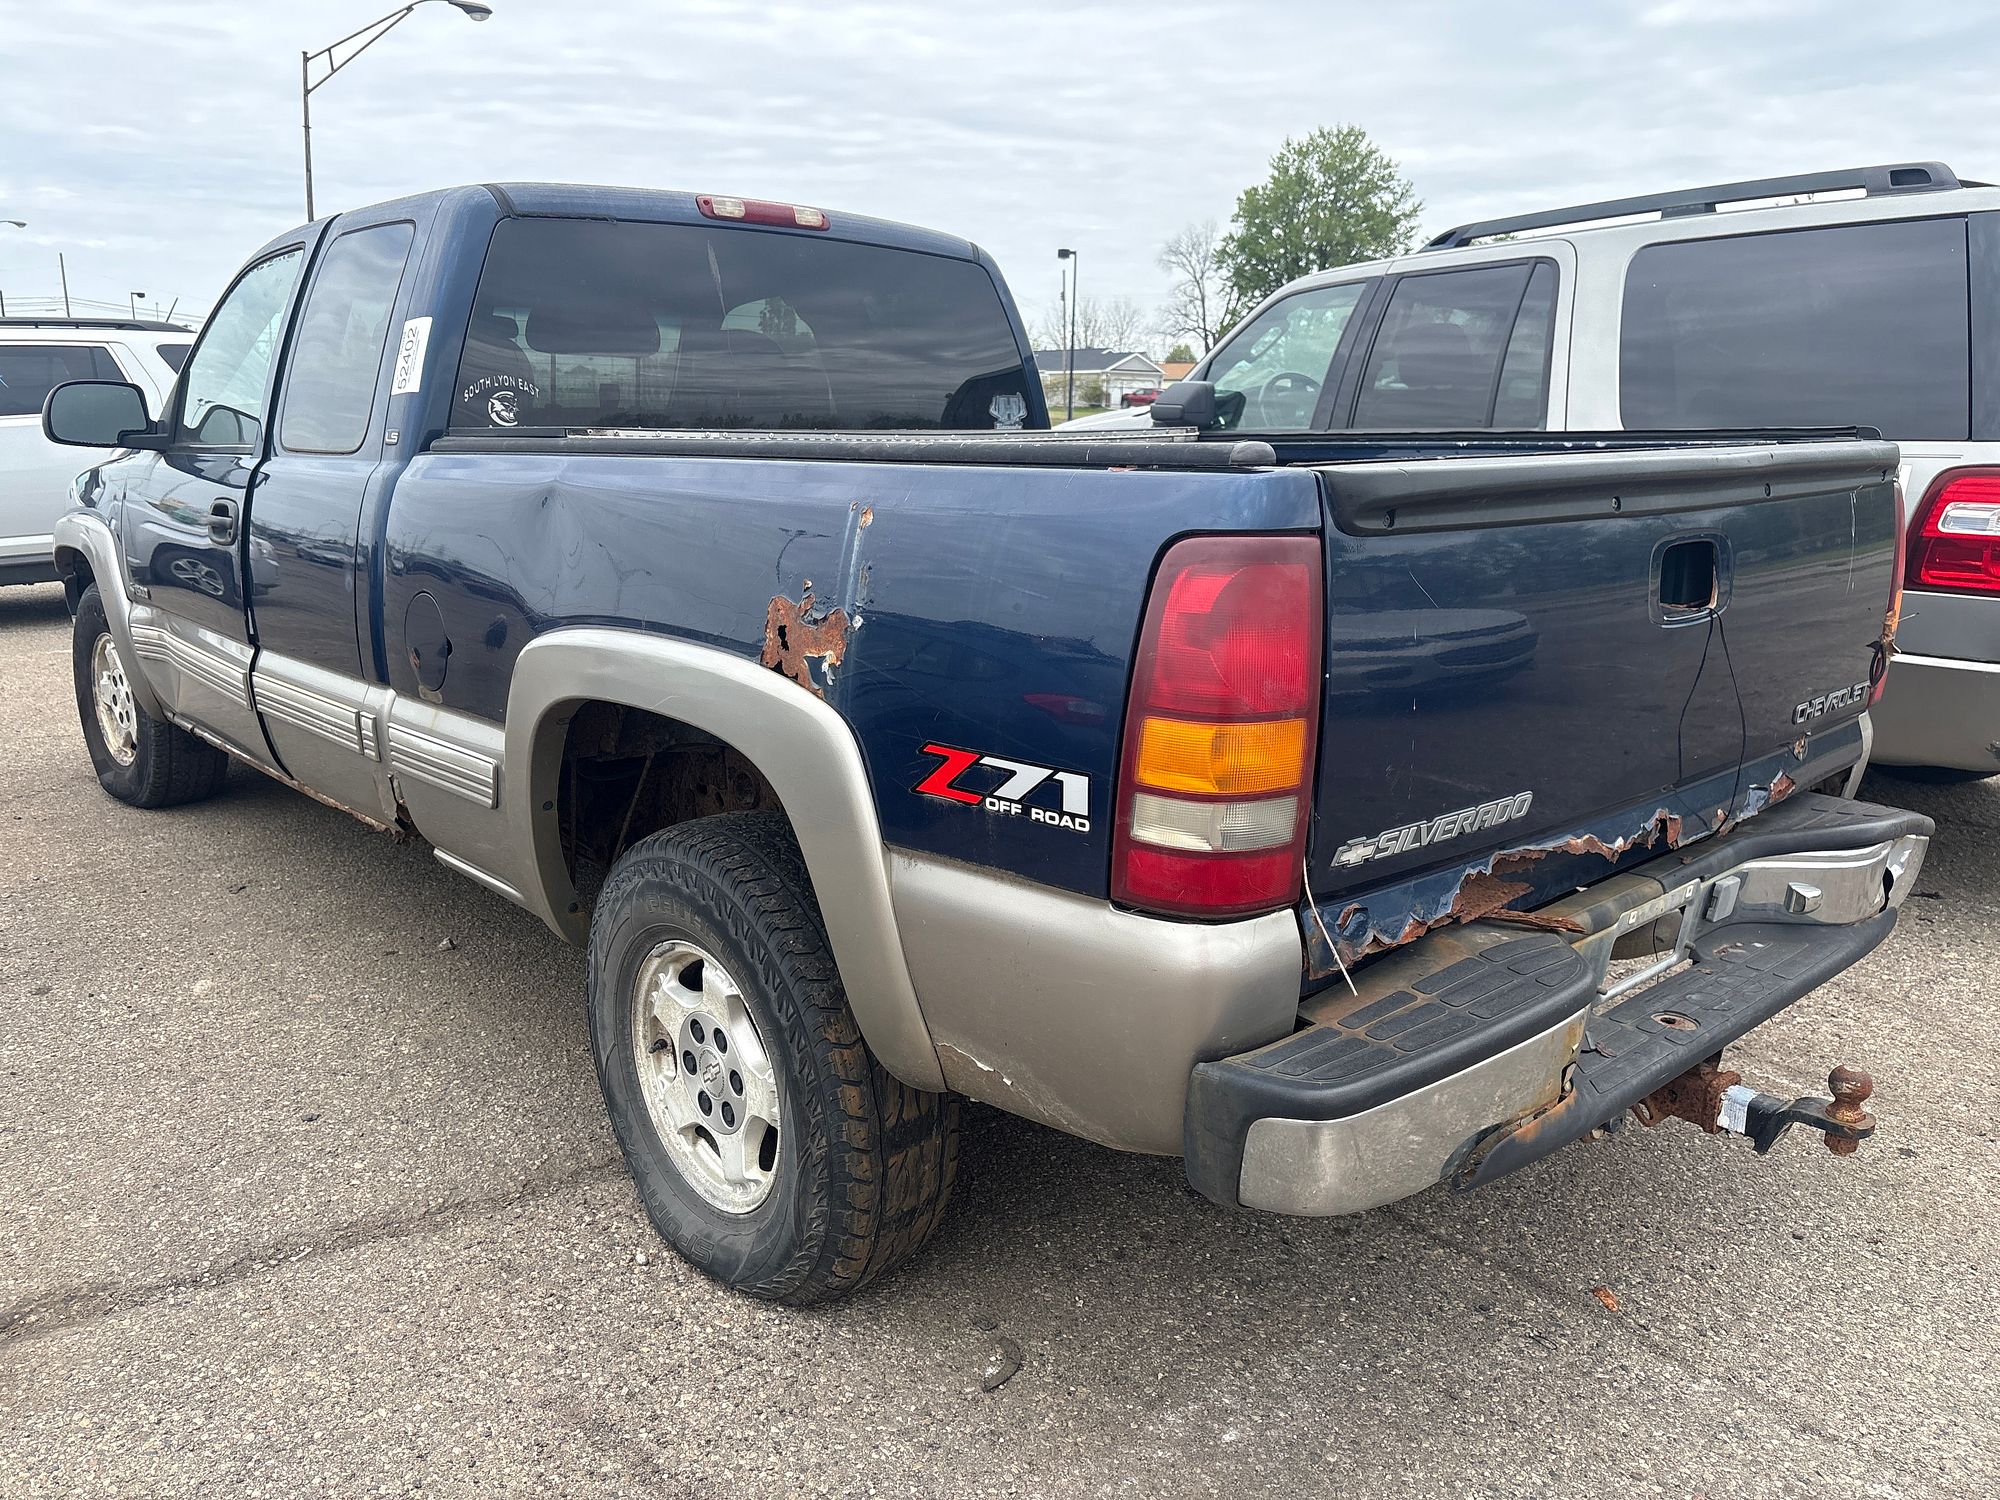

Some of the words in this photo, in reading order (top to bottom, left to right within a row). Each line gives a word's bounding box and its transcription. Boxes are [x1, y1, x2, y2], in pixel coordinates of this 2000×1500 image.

[397, 326, 418, 390] 52402
[463, 379, 492, 402] SOUTH
[493, 374, 516, 388] LYON
[518, 378, 540, 398] EAST
[385, 431, 399, 442] LS
[1794, 681, 1871, 723] CHEVROLET
[915, 743, 1090, 817] Z71
[985, 797, 1022, 816] OFF
[1031, 807, 1091, 832] ROAD
[1374, 791, 1533, 859] SILVERADO
